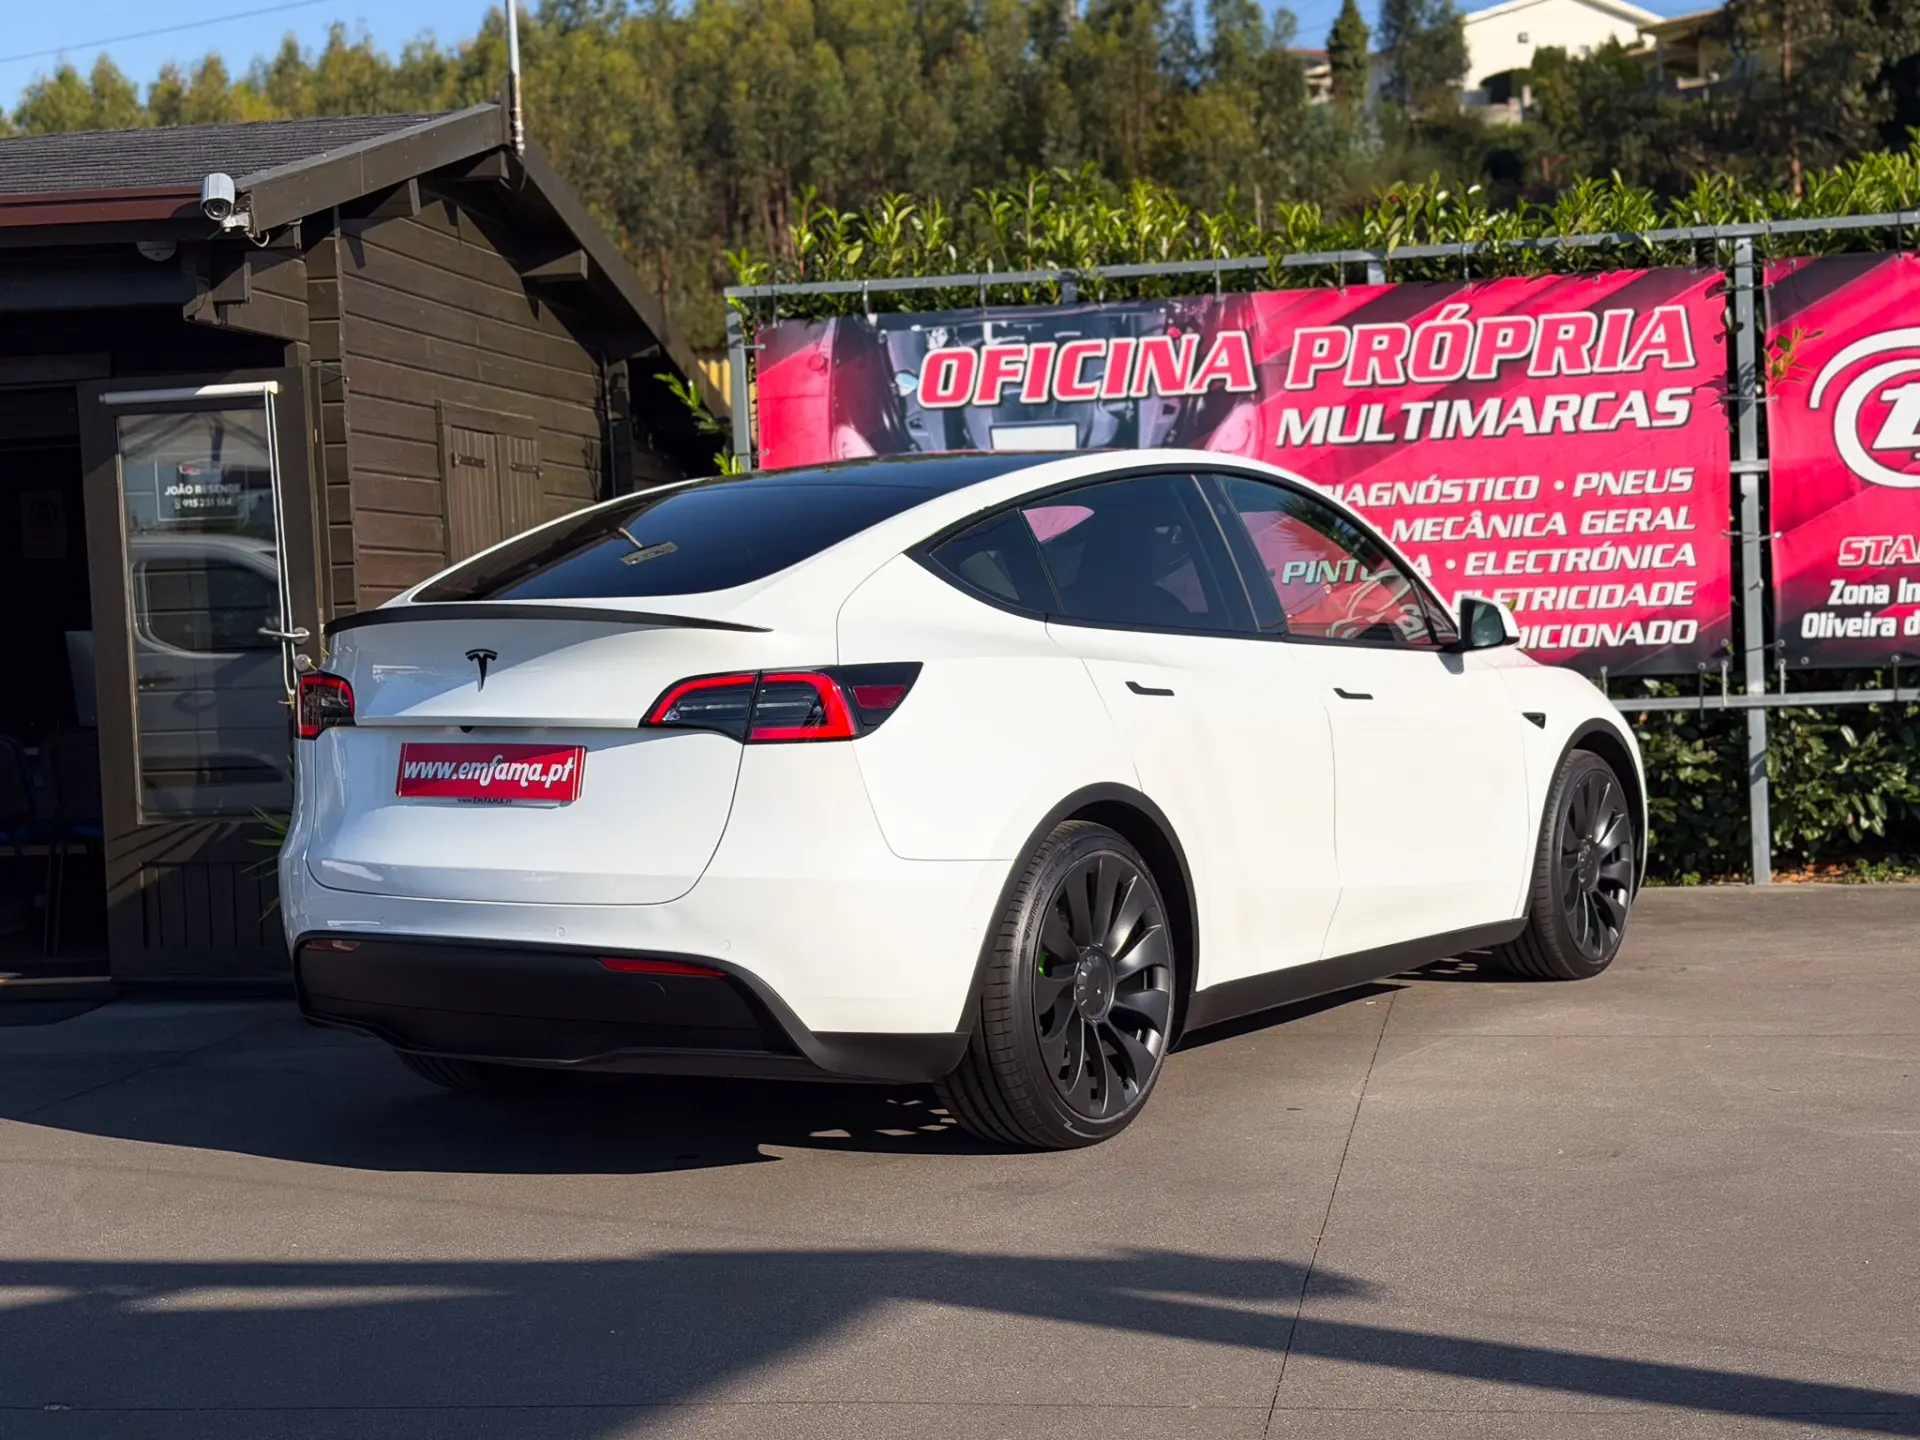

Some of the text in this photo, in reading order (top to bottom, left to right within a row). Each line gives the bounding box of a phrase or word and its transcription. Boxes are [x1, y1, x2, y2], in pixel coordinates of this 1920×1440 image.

[919, 303, 1697, 408] OFICINA PRÓPRIA
[1276, 387, 1694, 447] MULTIMARCAS
[164, 483, 193, 496] JOÃO
[1573, 467, 1695, 498] PNEUS
[1390, 506, 1697, 543] MECÂNICA GERAL
[1464, 541, 1697, 576] ELECTRÓNICA
[1838, 535, 1920, 566] STA
[1827, 579, 1890, 605] Zona
[1801, 611, 1897, 639] Oliveira
[404, 754, 574, 788] www.emfama.pt
